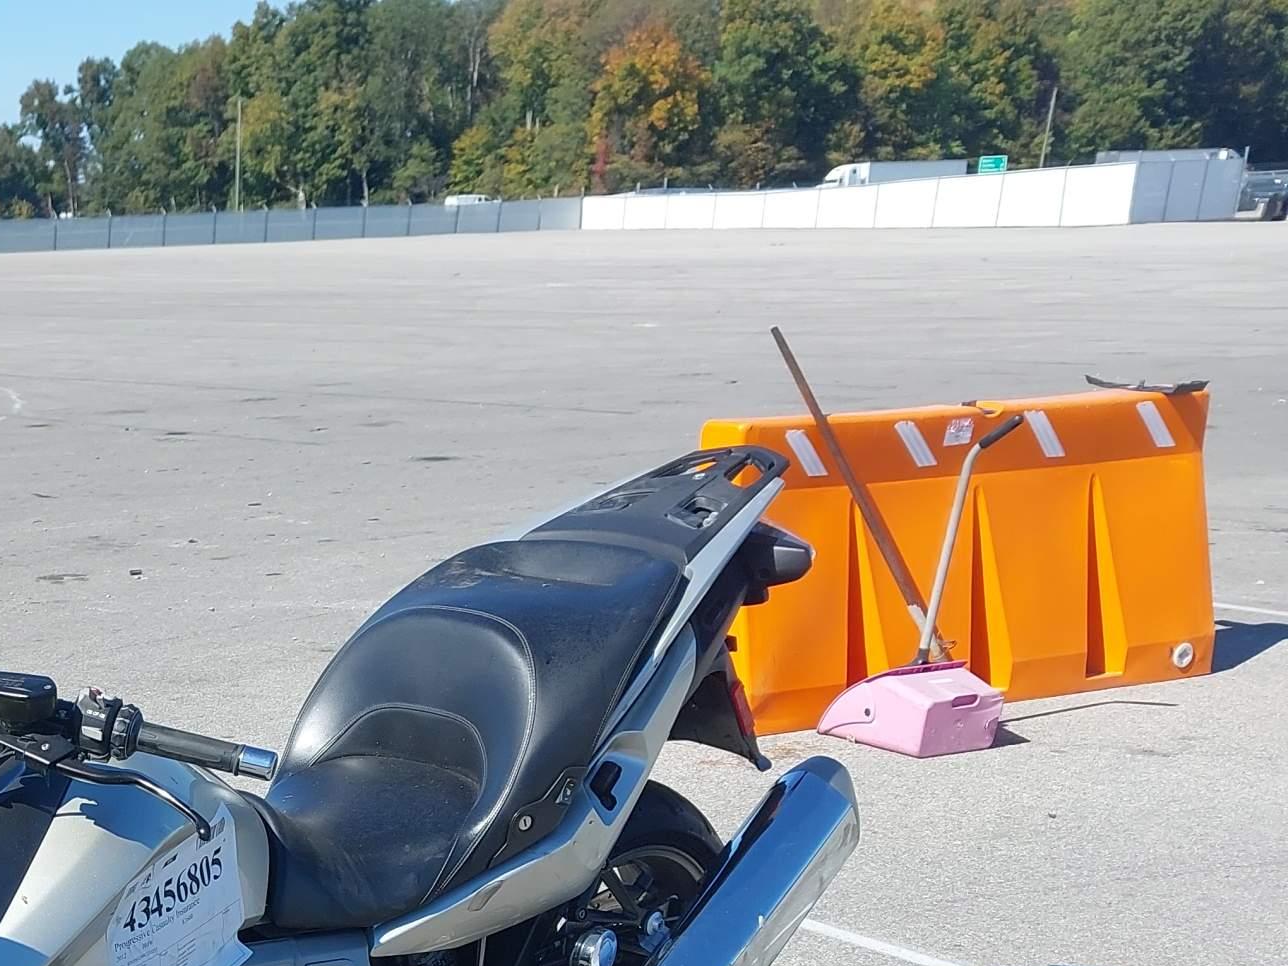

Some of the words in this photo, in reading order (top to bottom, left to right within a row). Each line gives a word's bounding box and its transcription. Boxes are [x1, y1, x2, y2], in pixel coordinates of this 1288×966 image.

[122, 845, 223, 932] 43456805
[114, 929, 151, 953] Progressive
[151, 914, 175, 935] Casualty
[175, 897, 200, 918] Insurance
